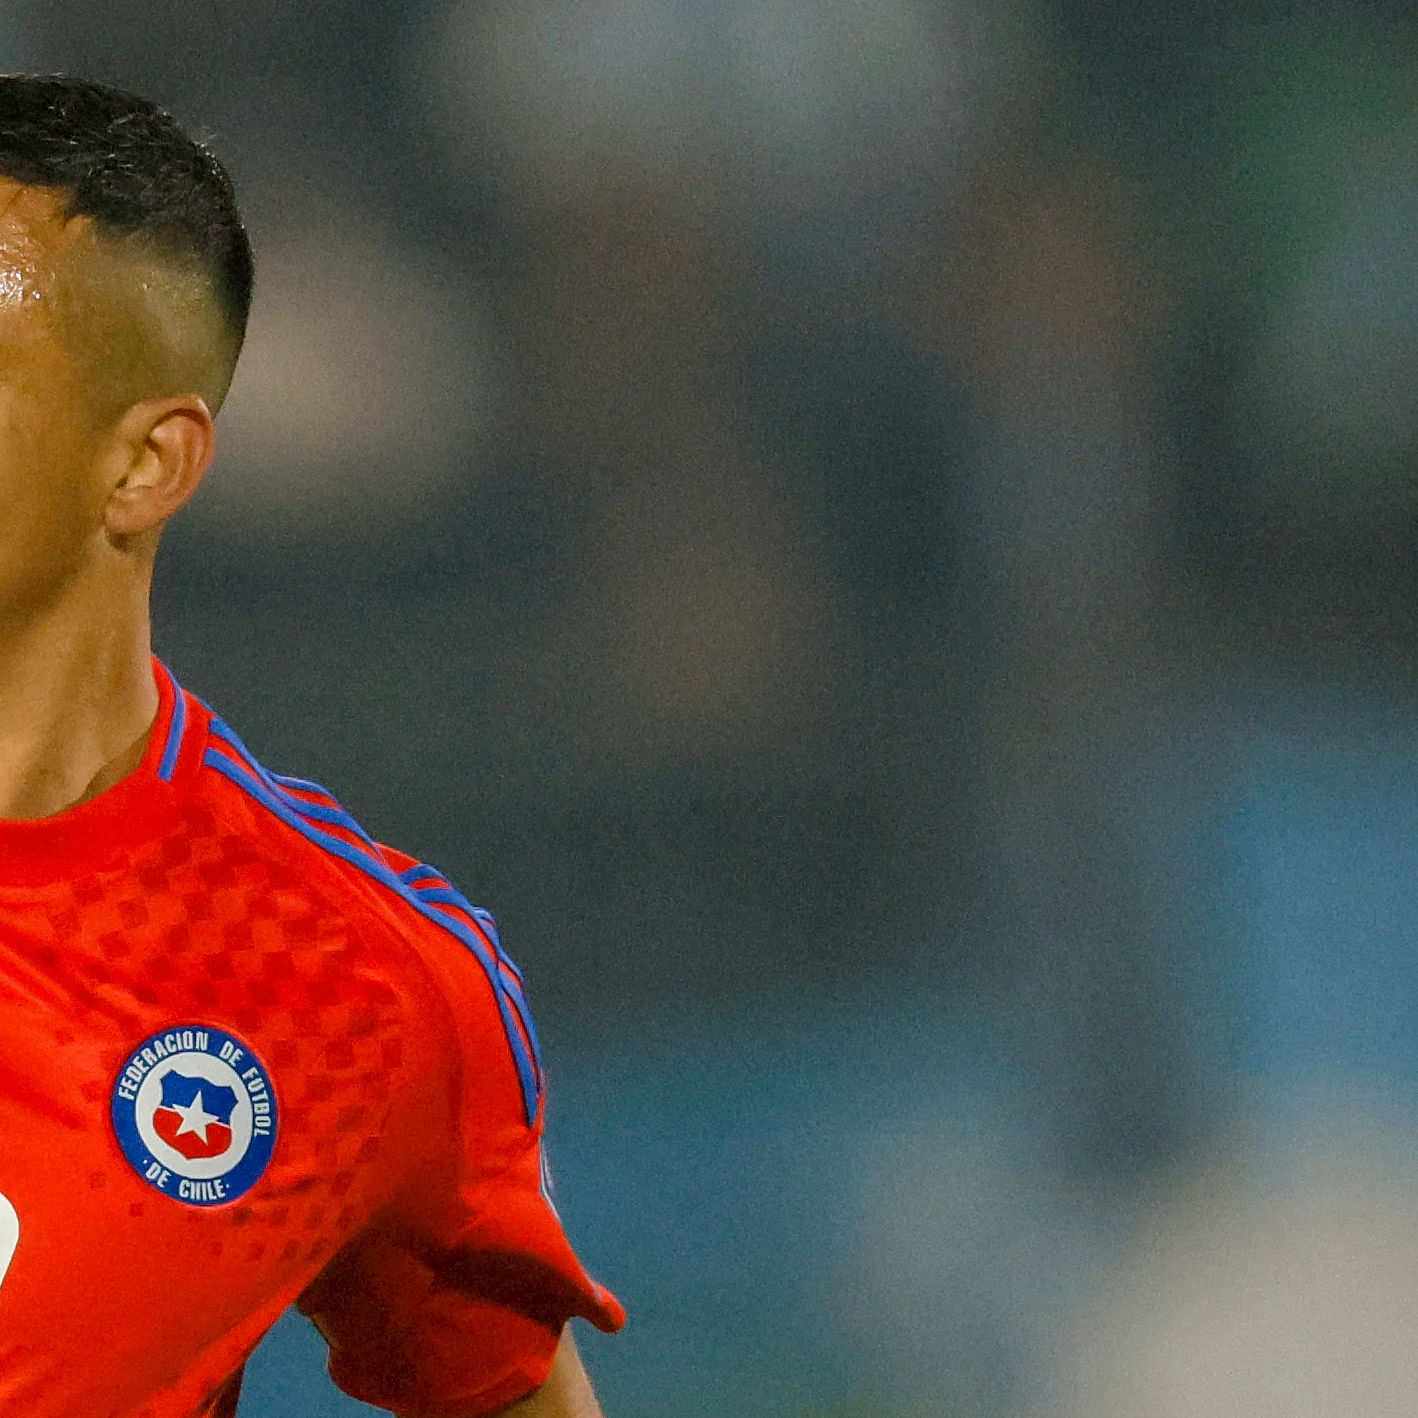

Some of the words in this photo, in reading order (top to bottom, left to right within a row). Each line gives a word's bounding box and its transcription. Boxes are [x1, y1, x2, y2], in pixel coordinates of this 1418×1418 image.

[118, 1030, 209, 1101] FEDERACION
[219, 1039, 244, 1067] DE
[241, 1066, 272, 1137] FUTBOL
[144, 1161, 172, 1188] DE
[178, 1178, 226, 1201] CHILE
